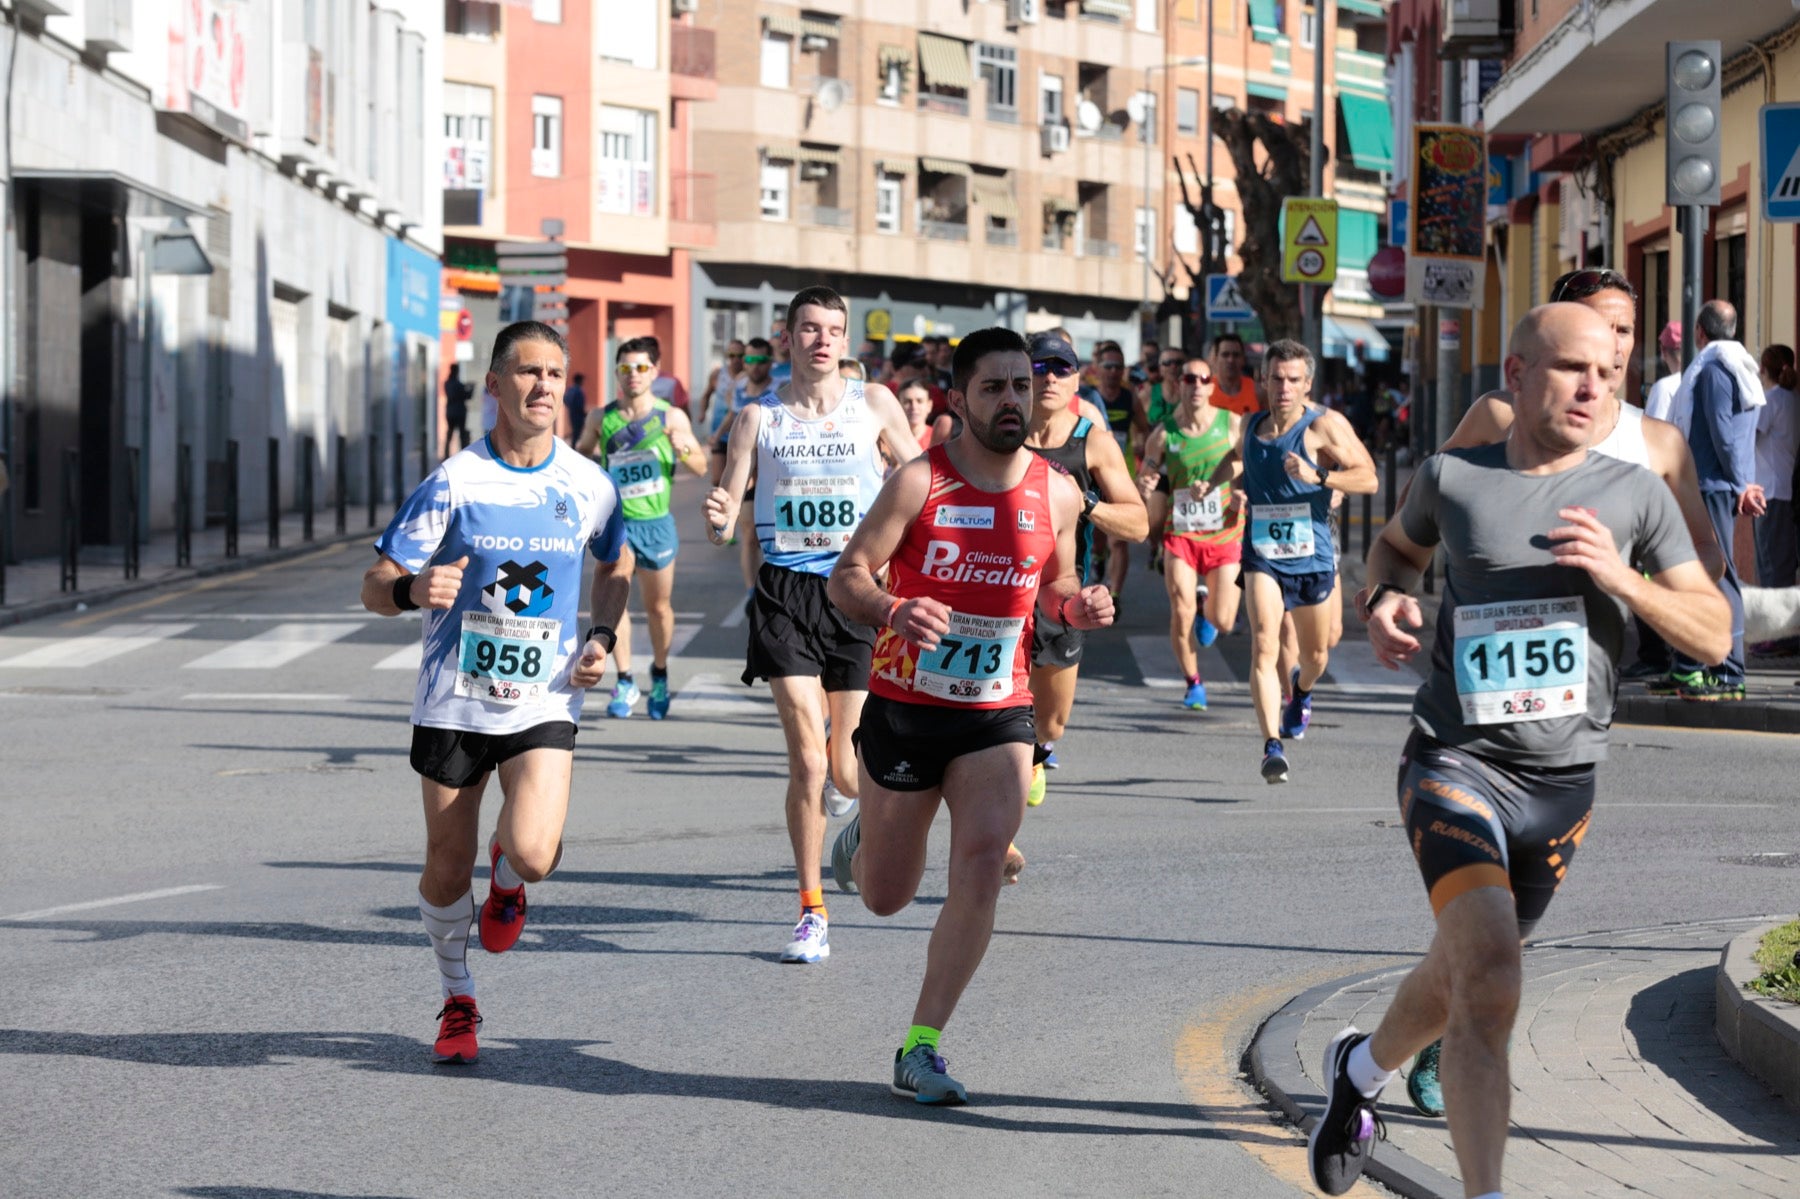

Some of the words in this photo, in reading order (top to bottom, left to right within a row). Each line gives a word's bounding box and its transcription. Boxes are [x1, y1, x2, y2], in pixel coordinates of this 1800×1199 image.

[773, 443, 856, 459] MARACENA
[617, 464, 653, 484] 350
[794, 478, 808, 487] GRAN
[809, 478, 829, 486] PREMIO
[830, 478, 837, 486] DE
[780, 499, 856, 527] 1088
[1180, 500, 1217, 516] 3018
[1269, 522, 1294, 541] 67
[472, 535, 524, 551] TODO
[529, 537, 576, 553] SUMA
[921, 539, 1039, 588] Polisalud
[965, 551, 1013, 566] Clínicas
[1482, 607, 1505, 619] GRAN
[1506, 604, 1538, 617] PREMIO
[1539, 603, 1549, 615] DE
[1551, 601, 1578, 613] FONDO
[469, 613, 487, 622] XXXIII
[487, 615, 504, 625] GRAN
[505, 618, 528, 629] PREMIO
[528, 620, 536, 629] DE
[537, 621, 557, 630] FONDO
[953, 614, 970, 626] GRAN
[971, 617, 995, 628] PREMIO
[995, 619, 1002, 629] DE
[475, 640, 542, 678] 958
[940, 638, 1003, 675] 713
[1470, 637, 1576, 680] 1156
